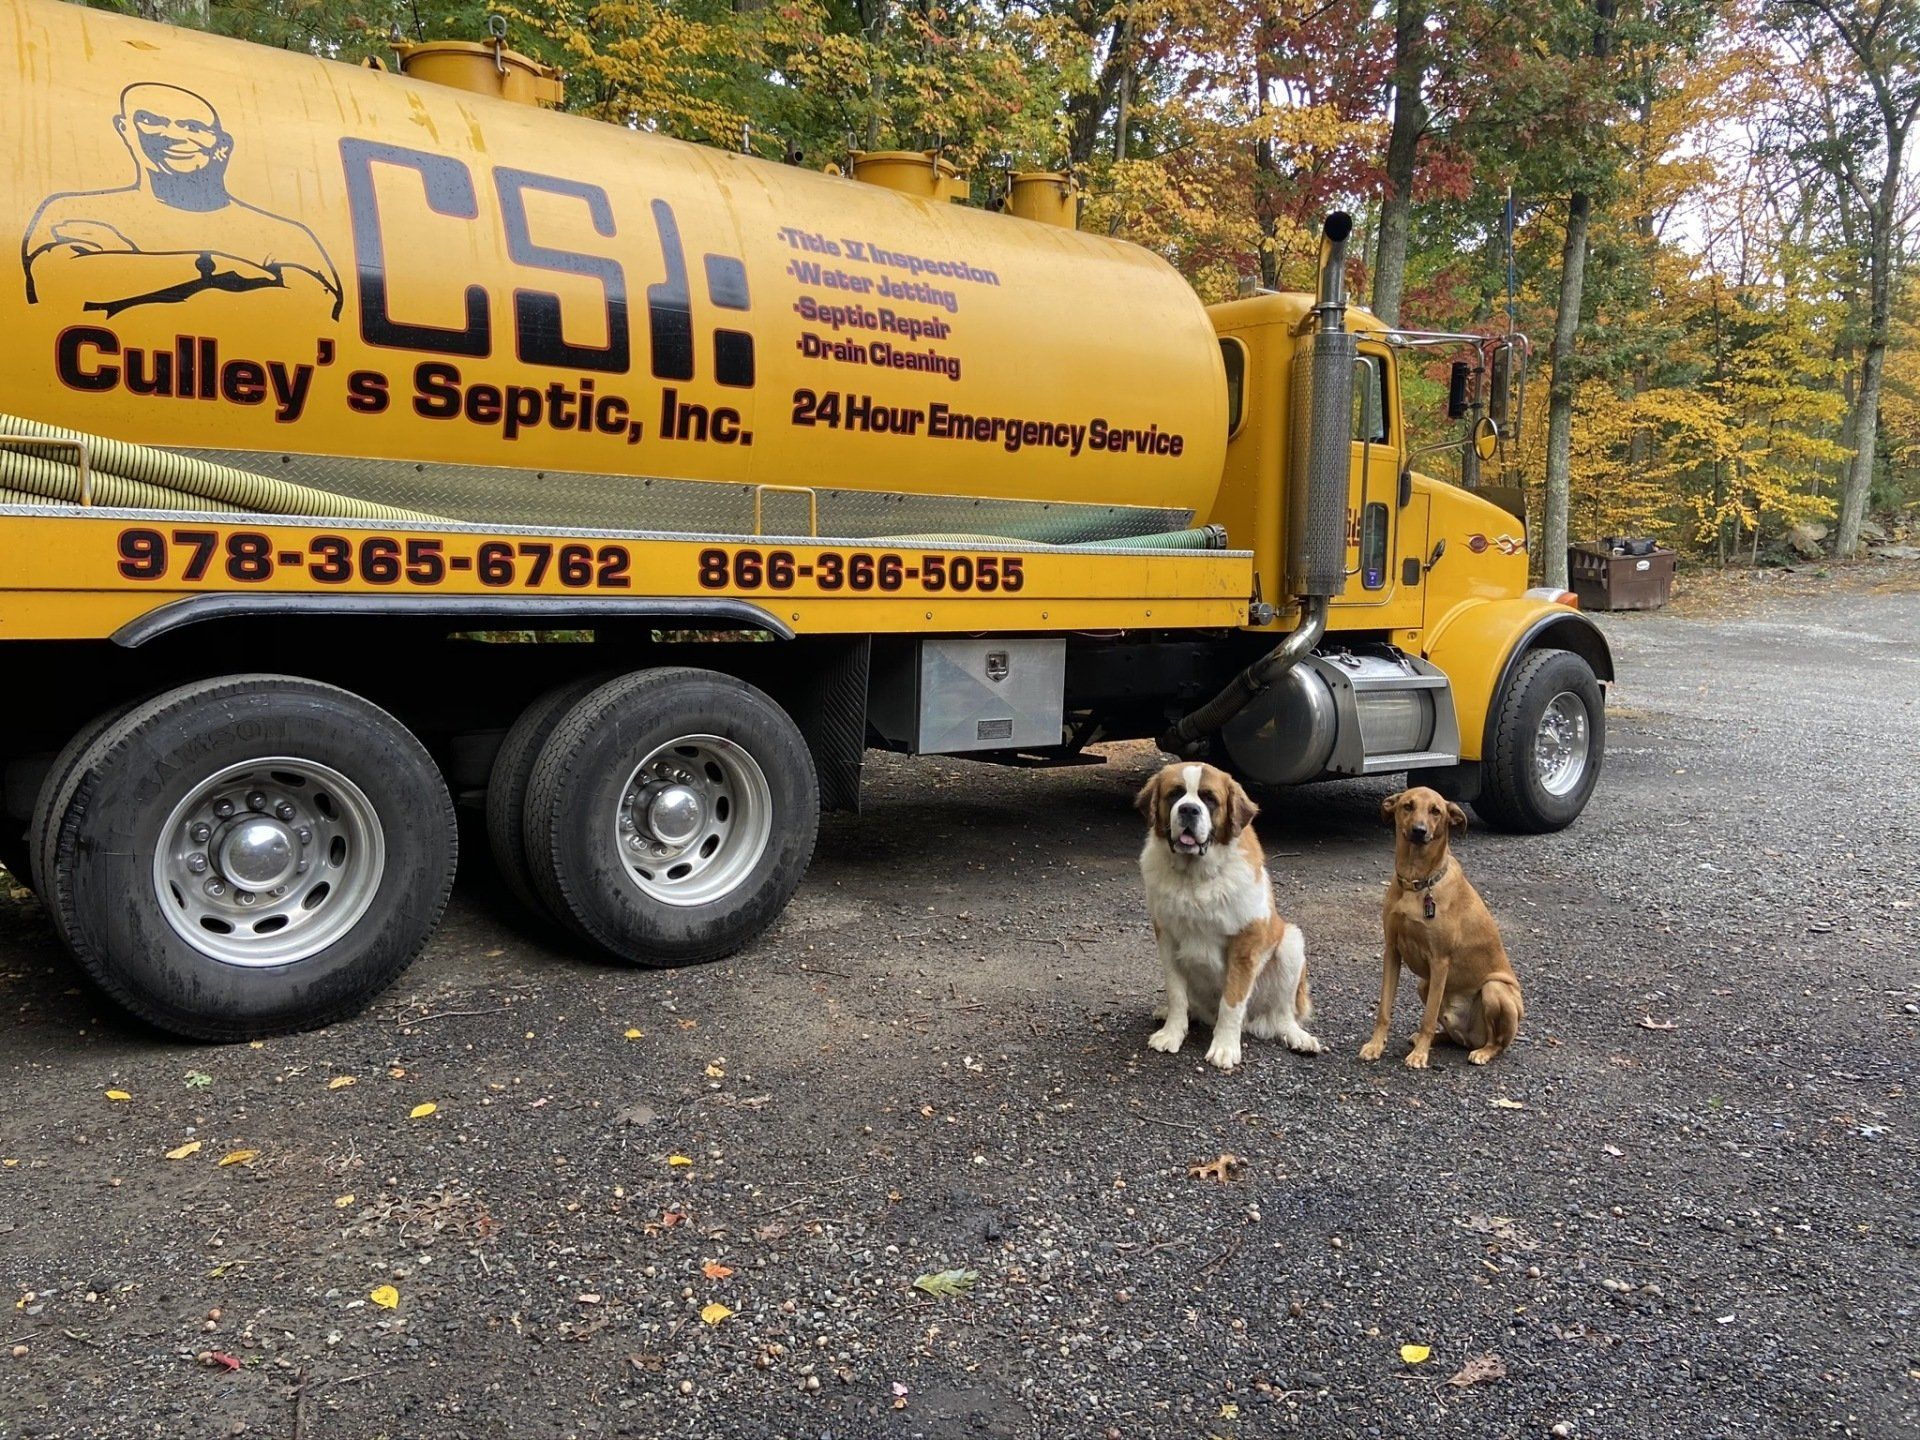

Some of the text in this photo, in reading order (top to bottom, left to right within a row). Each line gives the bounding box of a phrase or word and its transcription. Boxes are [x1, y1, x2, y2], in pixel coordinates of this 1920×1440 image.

[791, 259, 958, 313] Water Jetting
[867, 242, 1000, 286] Inspection
[799, 296, 951, 340] Septic Repair
[802, 332, 961, 381] Drain Cleaning
[55, 326, 753, 445] Culley's Septic, Inc.
[792, 389, 1184, 457] 24 Hour Emergency Service
[117, 529, 630, 589] 978-365-6762
[699, 549, 1024, 592] 866-366-5055
